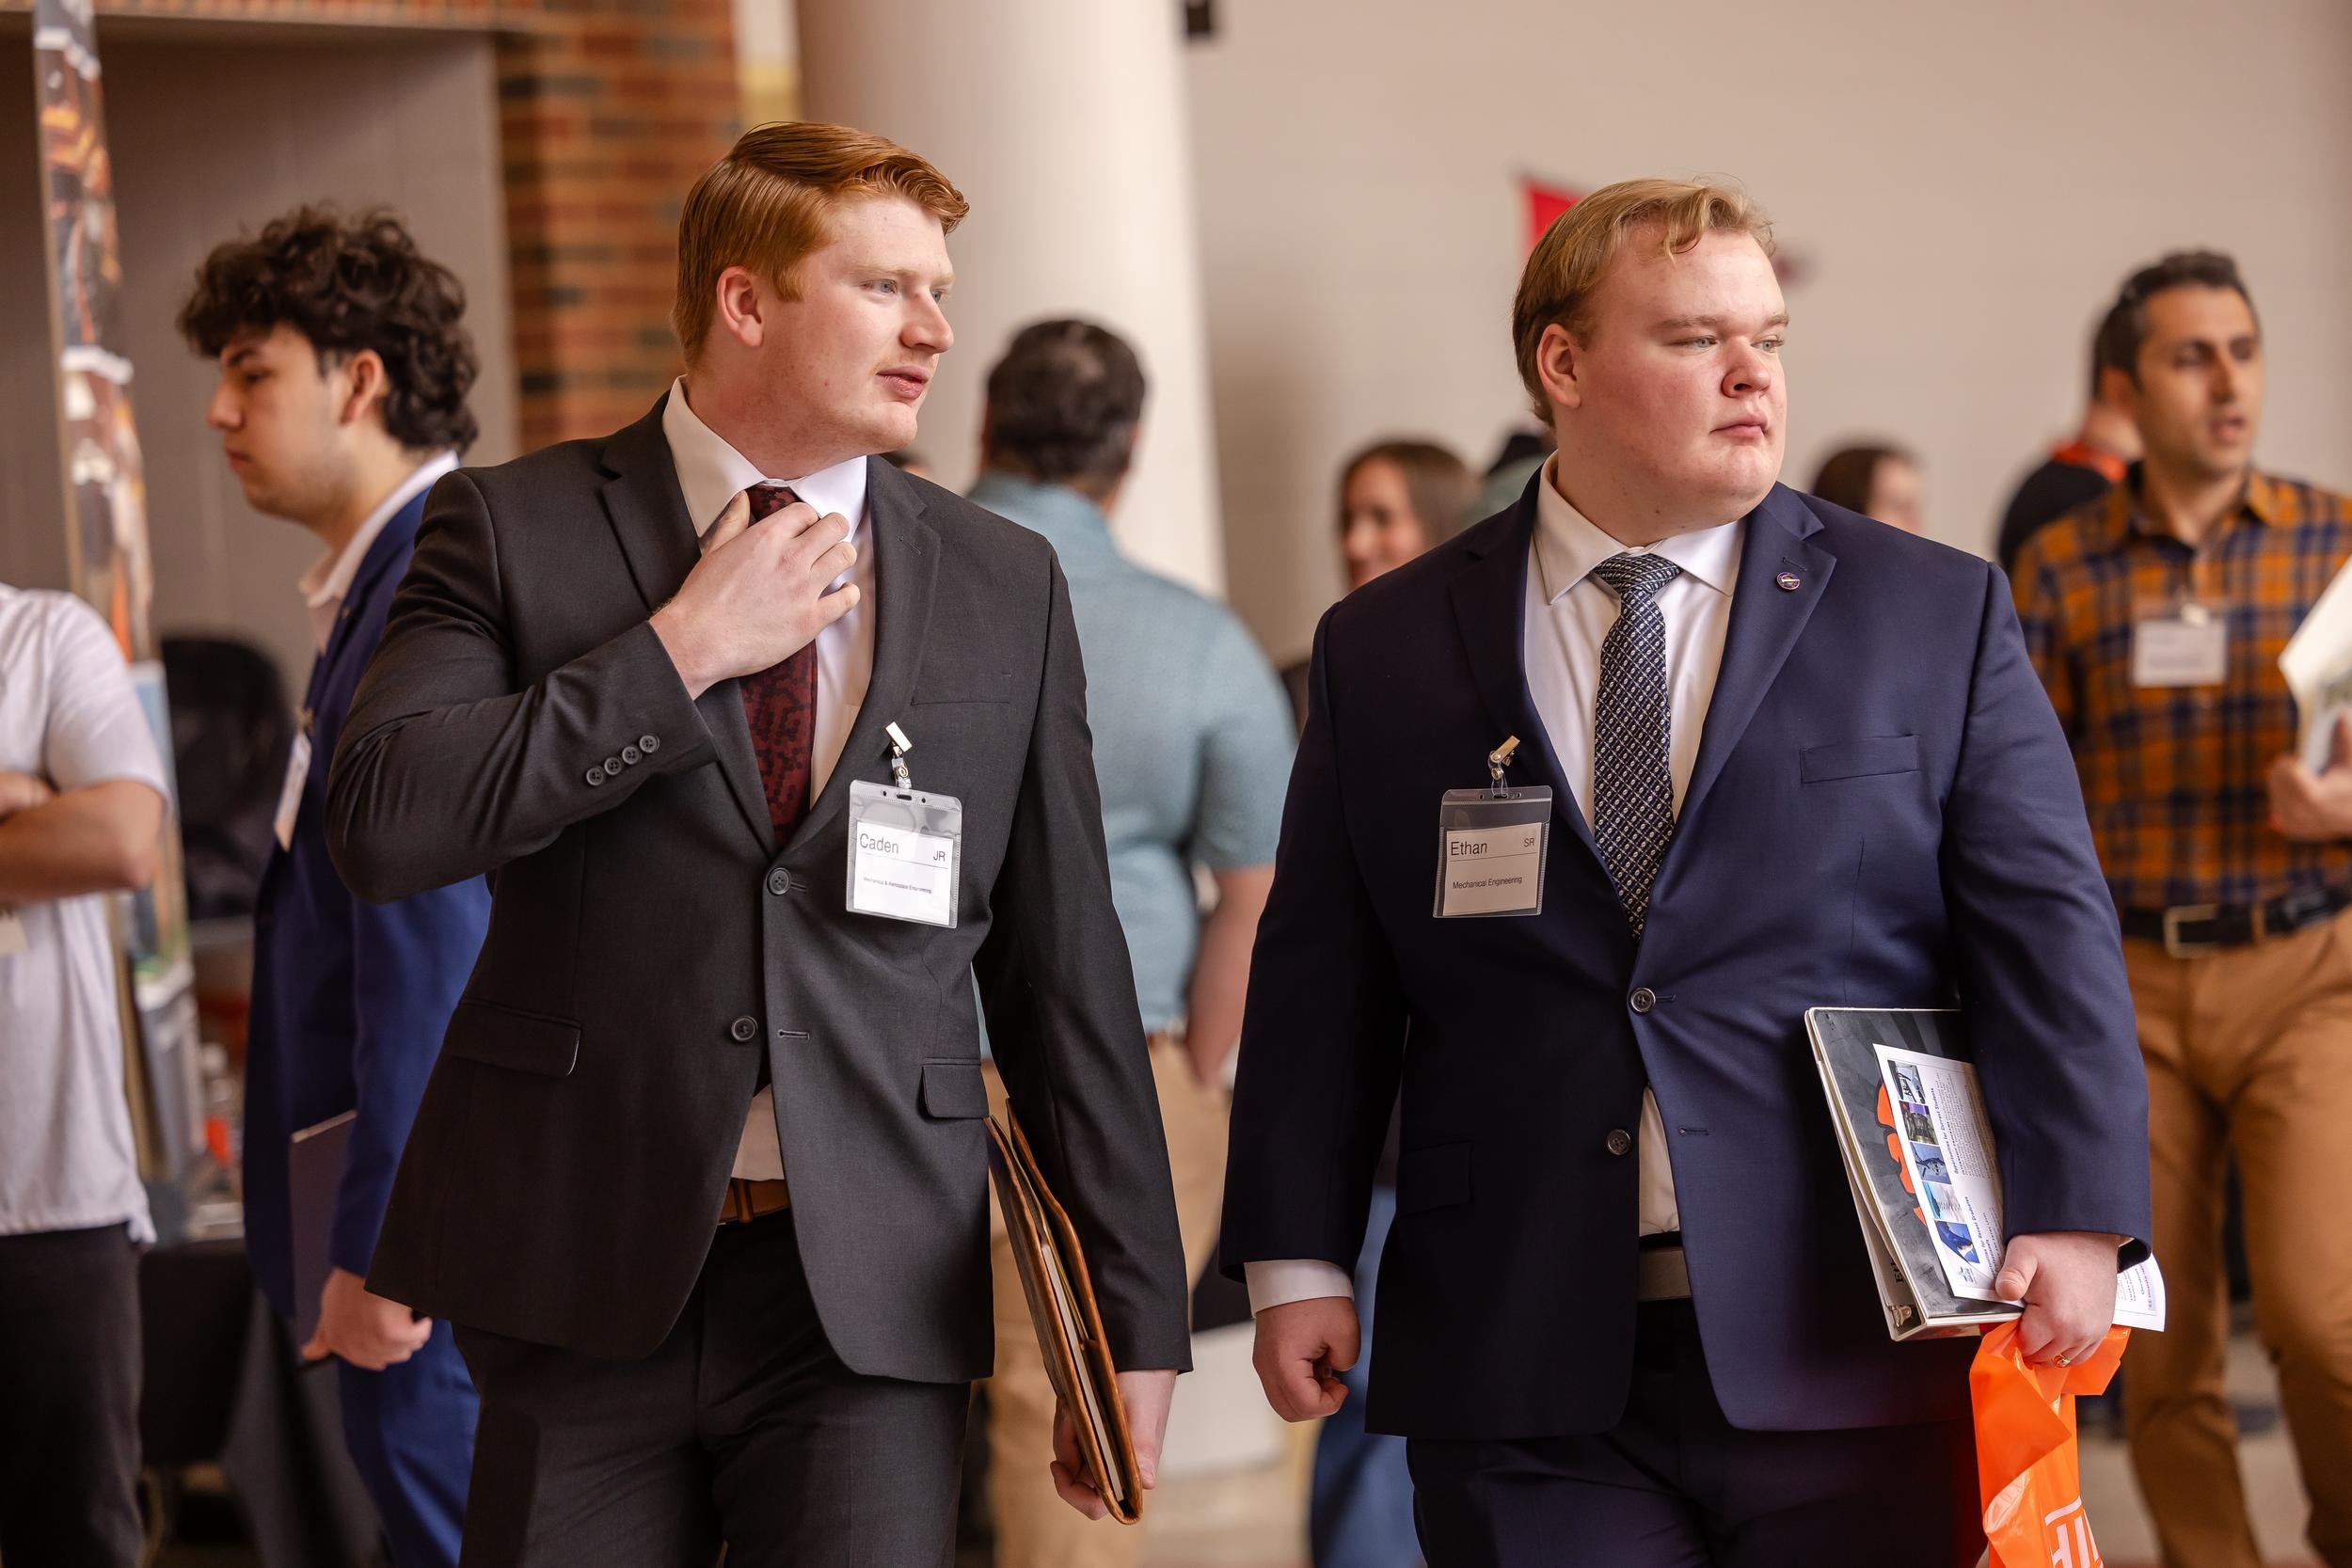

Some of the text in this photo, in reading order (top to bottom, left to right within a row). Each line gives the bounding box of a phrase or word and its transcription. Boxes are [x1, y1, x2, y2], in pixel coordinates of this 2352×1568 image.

[860, 833, 946, 863] Caden JR
[1451, 837, 1535, 856] Ethan SR
[1453, 877, 1522, 890] Mechanical Engineering
[1931, 1088, 1939, 1109] Students
[1946, 1141, 1959, 1174] Opportunities
